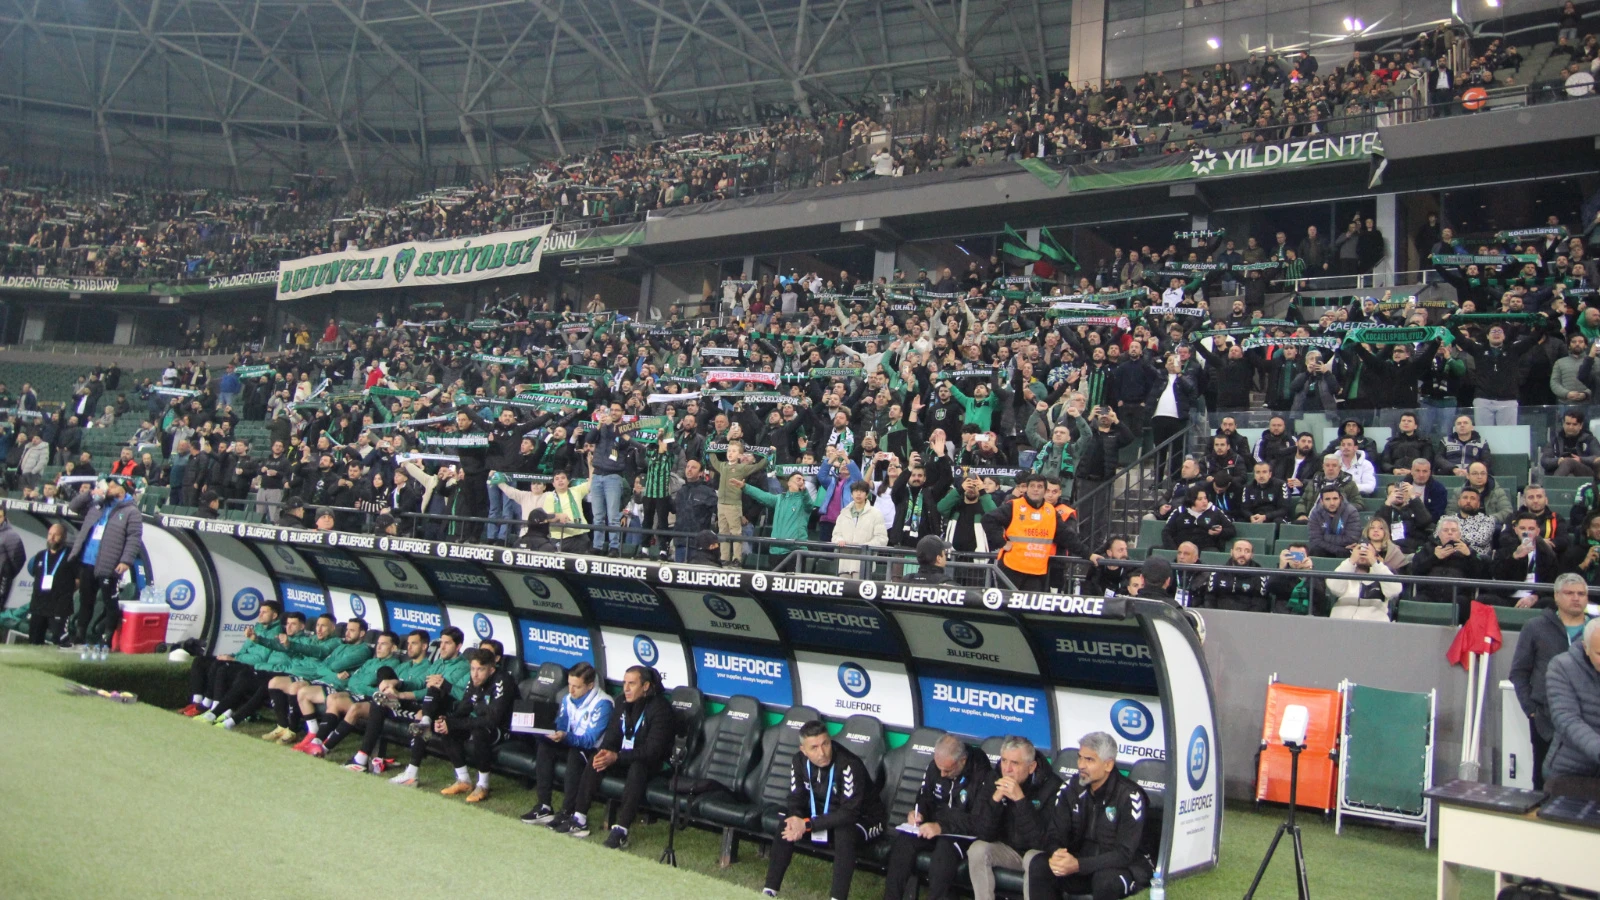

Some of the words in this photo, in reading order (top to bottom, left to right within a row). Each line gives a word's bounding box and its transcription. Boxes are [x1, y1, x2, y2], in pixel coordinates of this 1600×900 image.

[288, 530, 322, 544] BLUEFORCE
[338, 534, 374, 549] BLUEFORCE
[390, 539, 430, 554] BLUEFORCE
[449, 545, 494, 561] BLUEFORCE
[516, 553, 566, 570] BLUEFORCE
[591, 561, 647, 580] BLUEFORCE
[676, 570, 741, 588] BLUEFORCE
[771, 577, 844, 596] BLUEFORCE
[588, 587, 660, 606] BLUEFORCE
[881, 584, 966, 606] BLUEFORCE
[1007, 592, 1105, 615] BLUEFORCE
[394, 607, 441, 627] BLUEFORCE
[710, 620, 750, 632] BLUEFORCE
[787, 608, 880, 629] BLUEFORCE
[529, 627, 590, 651] BLUEFORCE
[704, 652, 782, 678] BLUEFORCE
[946, 649, 1000, 663] BLUEFORCE
[835, 699, 882, 713] BLUEFORCE
[933, 683, 1035, 715] BLUEFORCE
[1000, 714, 1023, 723] together
[1117, 744, 1166, 760] UEFORCE
